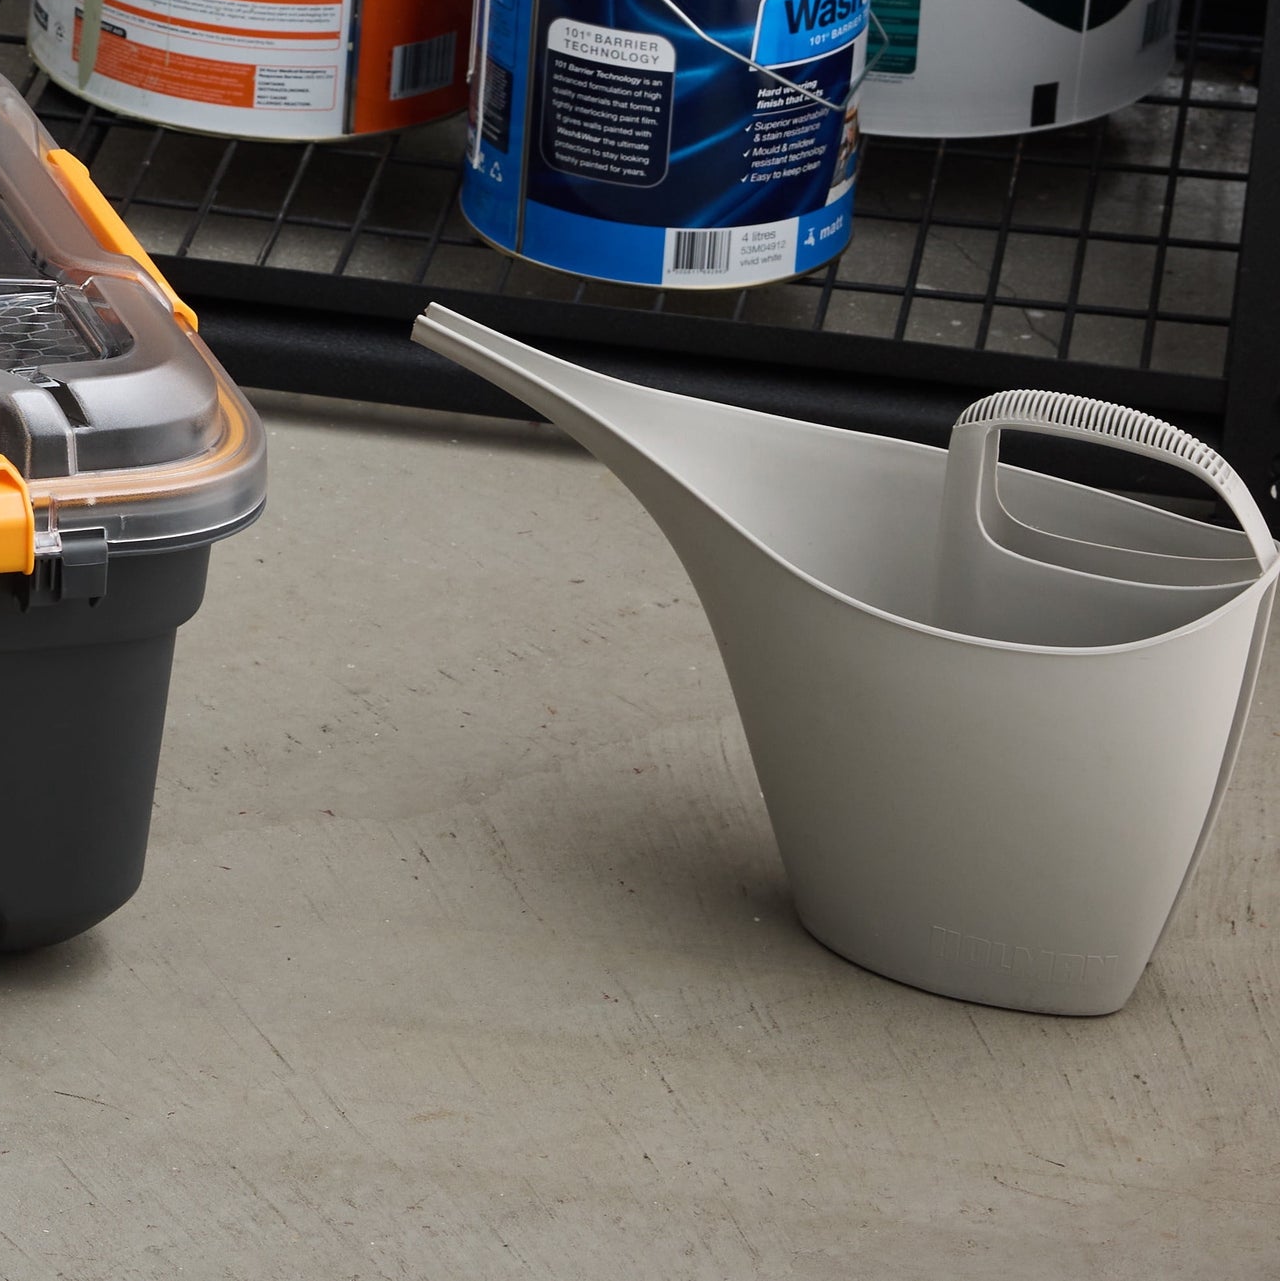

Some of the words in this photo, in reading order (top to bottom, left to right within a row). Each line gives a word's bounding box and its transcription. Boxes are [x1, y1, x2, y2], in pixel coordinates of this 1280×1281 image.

[563, 38, 660, 65] TECHNOLOGY
[594, 33, 659, 53] BARRIER
[554, 59, 568, 70] 101
[567, 63, 595, 76] Barrier
[596, 69, 642, 87] Technology
[642, 78, 651, 86] is
[651, 79, 663, 87] an
[552, 73, 588, 88] advanced
[588, 81, 633, 97] formulation
[633, 89, 643, 98] of
[643, 90, 662, 102] high
[552, 85, 576, 100] quality
[576, 92, 612, 107] materials
[612, 99, 629, 109] that
[629, 102, 653, 112] forms
[757, 86, 782, 98] Hard
[552, 98, 574, 112] tightly
[574, 103, 618, 122] interlocking
[619, 114, 641, 124] paint
[756, 99, 784, 110] finish
[785, 94, 804, 106] that
[562, 115, 582, 127] gives
[582, 120, 602, 131] walls
[602, 124, 634, 136] painted
[634, 129, 653, 139] with
[753, 118, 792, 132] Superior
[753, 133, 761, 143] &
[761, 131, 783, 143] stain
[783, 122, 822, 138] resistance
[556, 126, 602, 143] Wash&Wear
[602, 136, 617, 146] the
[616, 138, 650, 151] ultimate
[554, 139, 592, 155] protection
[592, 148, 601, 157] to
[601, 149, 620, 161] stay
[620, 152, 651, 166] looking
[750, 155, 788, 169] resistant
[788, 143, 828, 162] technology
[751, 145, 781, 157] Mould
[781, 143, 788, 153] &
[579, 158, 609, 172] painted
[609, 164, 621, 173] for
[621, 167, 647, 177] years.
[750, 172, 772, 183] Easy
[772, 170, 782, 180] to
[782, 166, 801, 178] keep
[741, 231, 749, 243] 4
[751, 230, 777, 242] litres
[819, 215, 845, 240] matt
[739, 257, 760, 268] vivid
[760, 253, 783, 265] white
